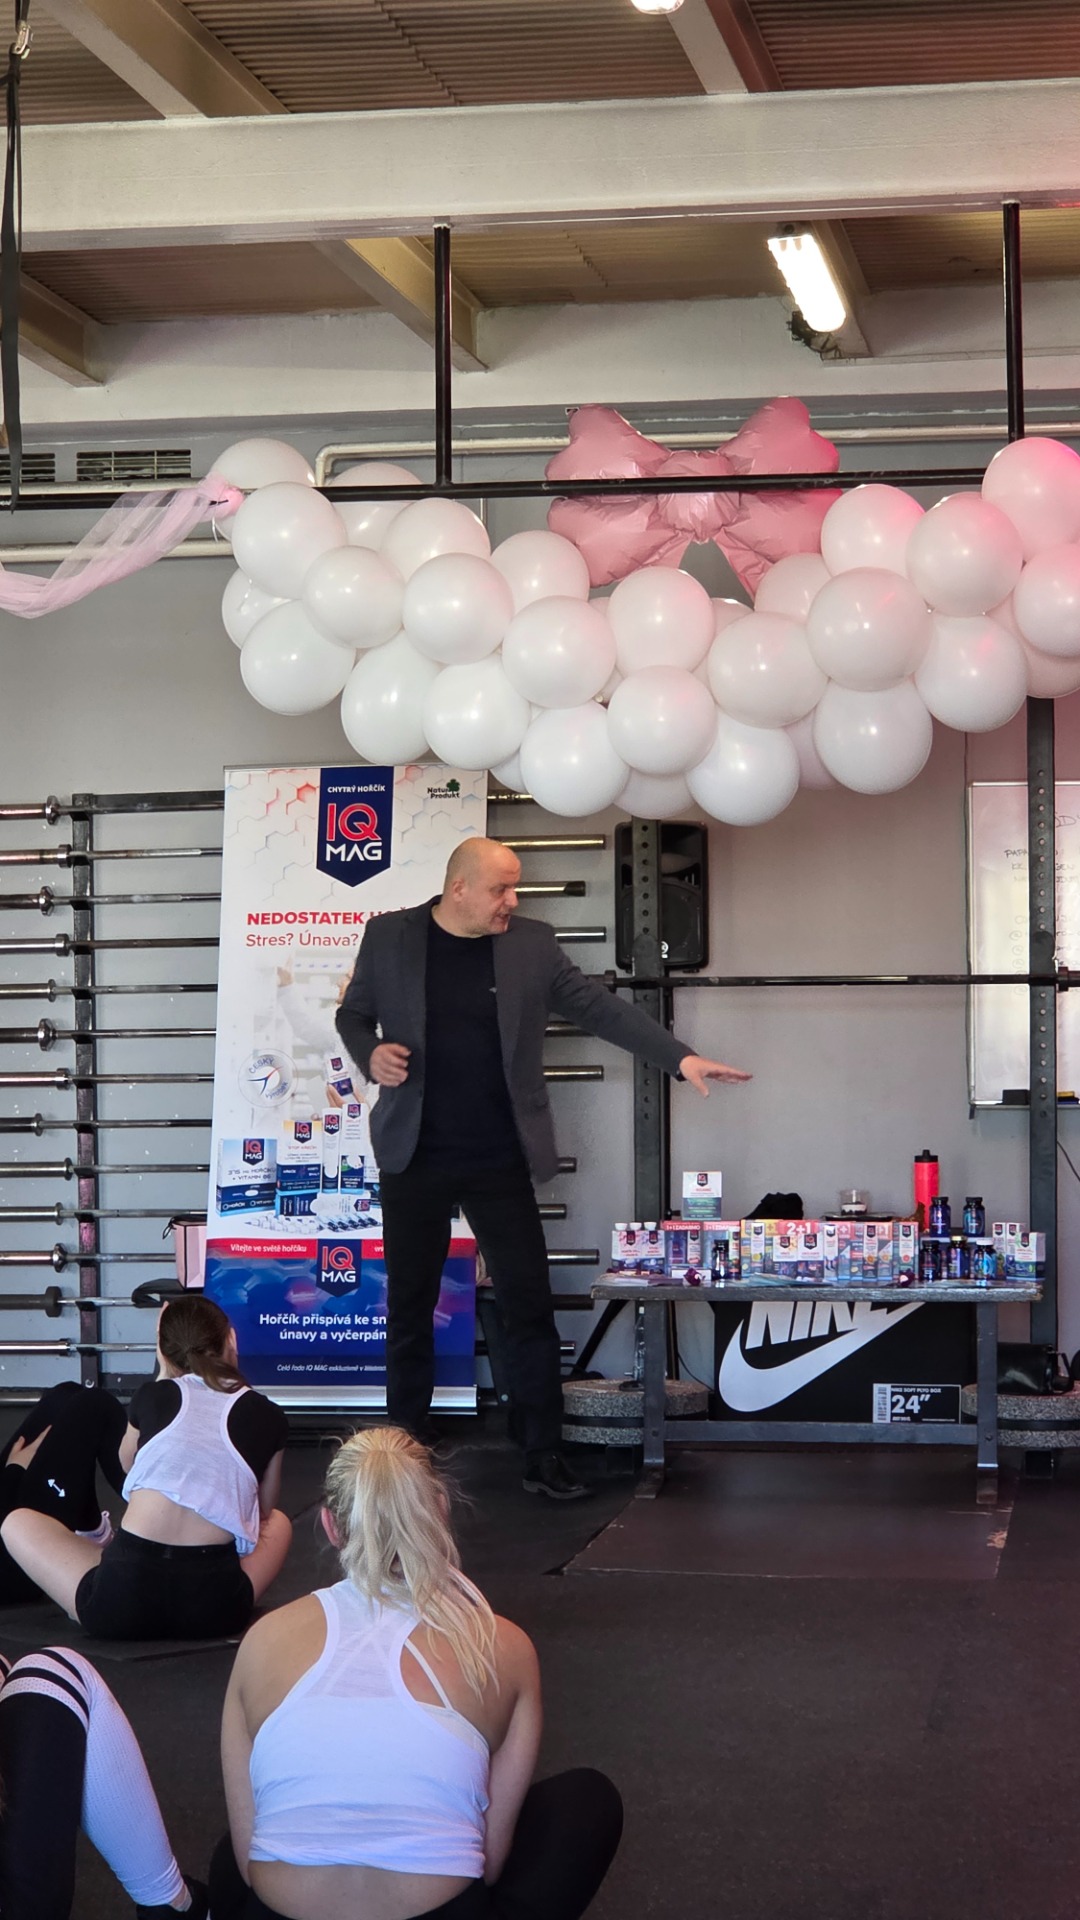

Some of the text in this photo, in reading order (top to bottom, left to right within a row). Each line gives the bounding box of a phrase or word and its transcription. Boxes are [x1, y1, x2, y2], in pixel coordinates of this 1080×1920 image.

[327, 783, 386, 794] CHYTRÝ HOŘČÍK
[326, 803, 382, 842] IQ
[326, 842, 382, 862] MAG
[247, 910, 365, 926] NEDOSTATEK
[246, 930, 359, 947] Stres? Únava?
[296, 1123, 310, 1133] IQ
[245, 1140, 262, 1153] IQ
[786, 1222, 812, 1235] 2+1
[231, 1243, 252, 1253] Vítejte
[322, 1246, 355, 1270] IQ
[321, 1271, 356, 1283] MAG
[260, 1313, 299, 1325] Hořčík
[303, 1313, 351, 1328] přispívá
[354, 1314, 369, 1325] ke
[280, 1329, 386, 1343] únavy a vyčerpán
